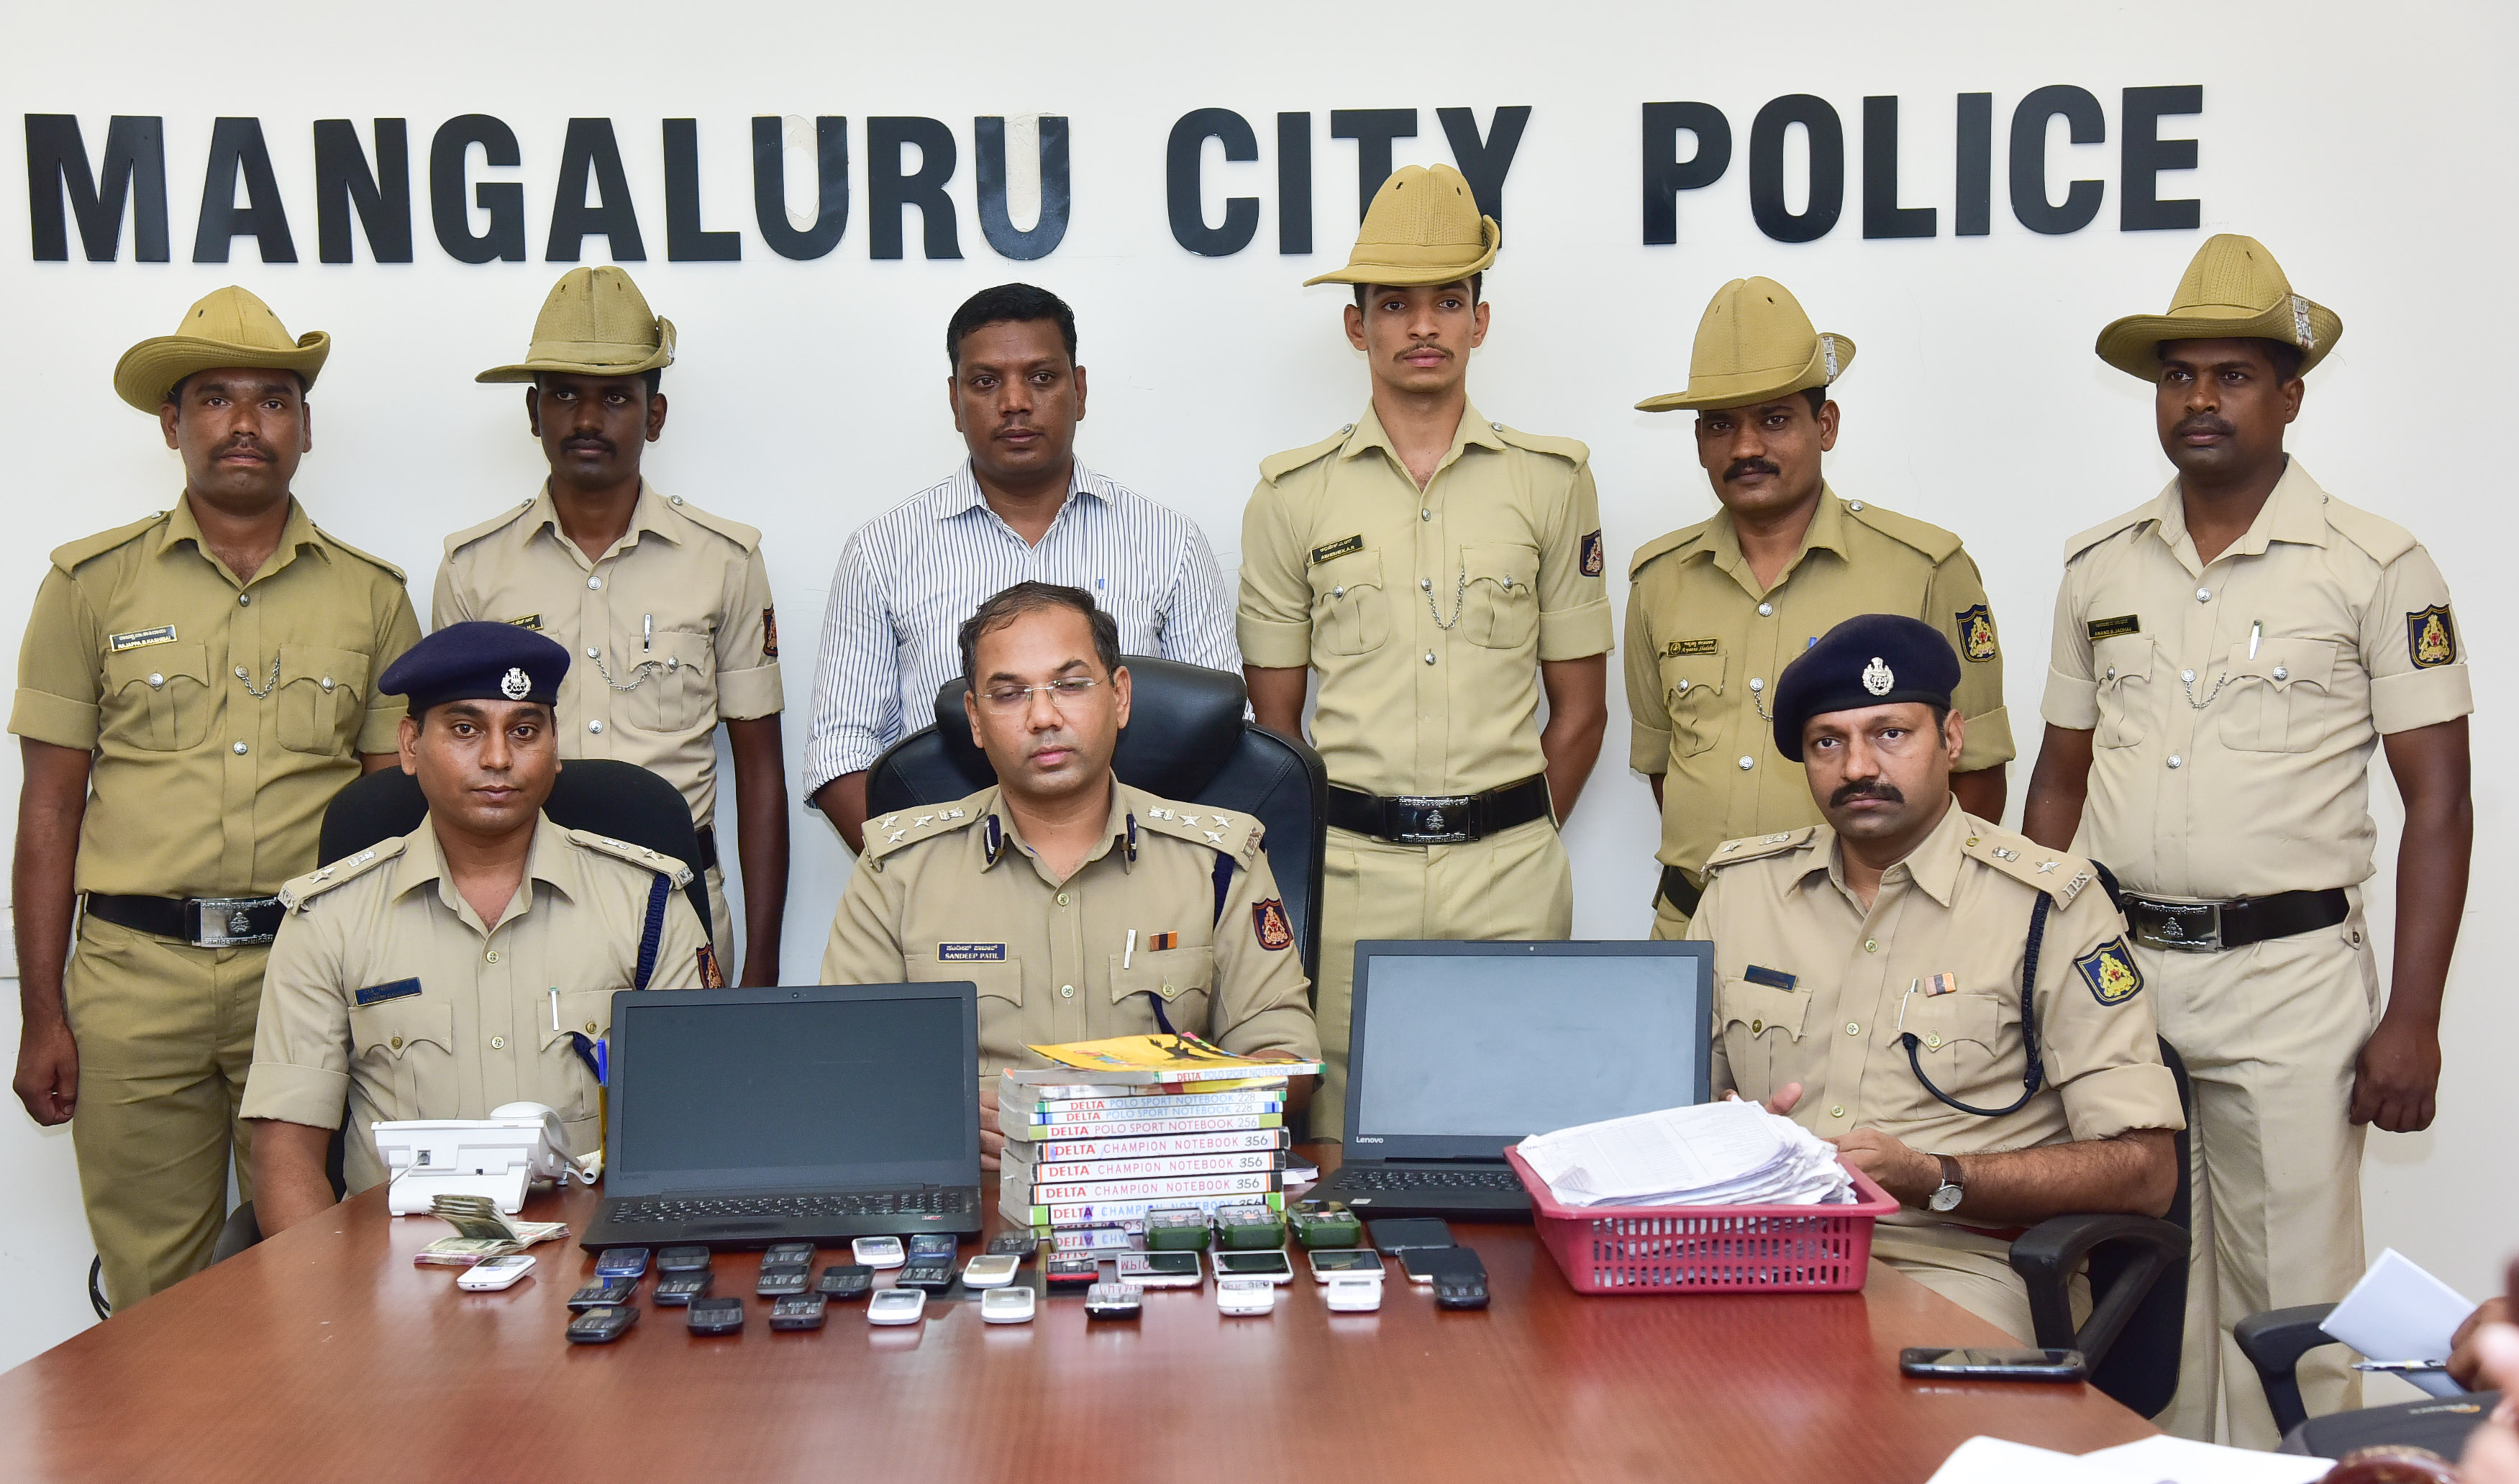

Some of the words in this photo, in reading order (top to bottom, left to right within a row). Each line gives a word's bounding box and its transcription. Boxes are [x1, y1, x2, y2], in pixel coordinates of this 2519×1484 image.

[24, 113, 1070, 263] MANGALURU
[1166, 105, 1533, 257] CITY
[1642, 84, 2203, 245] POLICE
[1177, 1072, 1201, 1082] DELTA
[1204, 1070, 1224, 1080] POLO
[1225, 1068, 1247, 1078] SPORT
[1249, 1066, 1290, 1078] NOTEBOOK
[1291, 1065, 1304, 1075] 228
[1070, 1101, 1105, 1110] DELTA
[1110, 1098, 1138, 1109] POLO
[1141, 1096, 1172, 1107] SPORT
[1176, 1094, 1234, 1105] NOTEBOOK
[1238, 1093, 1256, 1102] 228
[1066, 1112, 1101, 1121] DELTA
[1106, 1110, 1135, 1119] POLO
[1137, 1108, 1169, 1118] SPORT
[1172, 1106, 1231, 1116] NOTEBOOK
[1235, 1103, 1253, 1113] 228
[1051, 1126, 1089, 1137] DELTA
[1095, 1124, 1126, 1134] POLO
[1129, 1122, 1165, 1133] SPORT
[1168, 1119, 1234, 1131] NOTEBOOK
[1238, 1117, 1257, 1128] 256
[1055, 1144, 1095, 1156] DELTA
[1103, 1141, 1167, 1154] CHAMPION
[1175, 1137, 1239, 1150] NOTEBOOK
[1244, 1135, 1268, 1147] 356
[1049, 1165, 1090, 1177] DELTA
[1098, 1162, 1161, 1175] CHAMPION
[1170, 1158, 1234, 1170] NOTEBOOK
[1239, 1157, 1263, 1167] 356
[1046, 1187, 1087, 1198] DELTA
[1094, 1183, 1157, 1196] CHAMPION
[1166, 1180, 1230, 1192] NOTEBOOK
[1236, 1178, 1260, 1189] 356
[1053, 1207, 1093, 1219] DELTA
